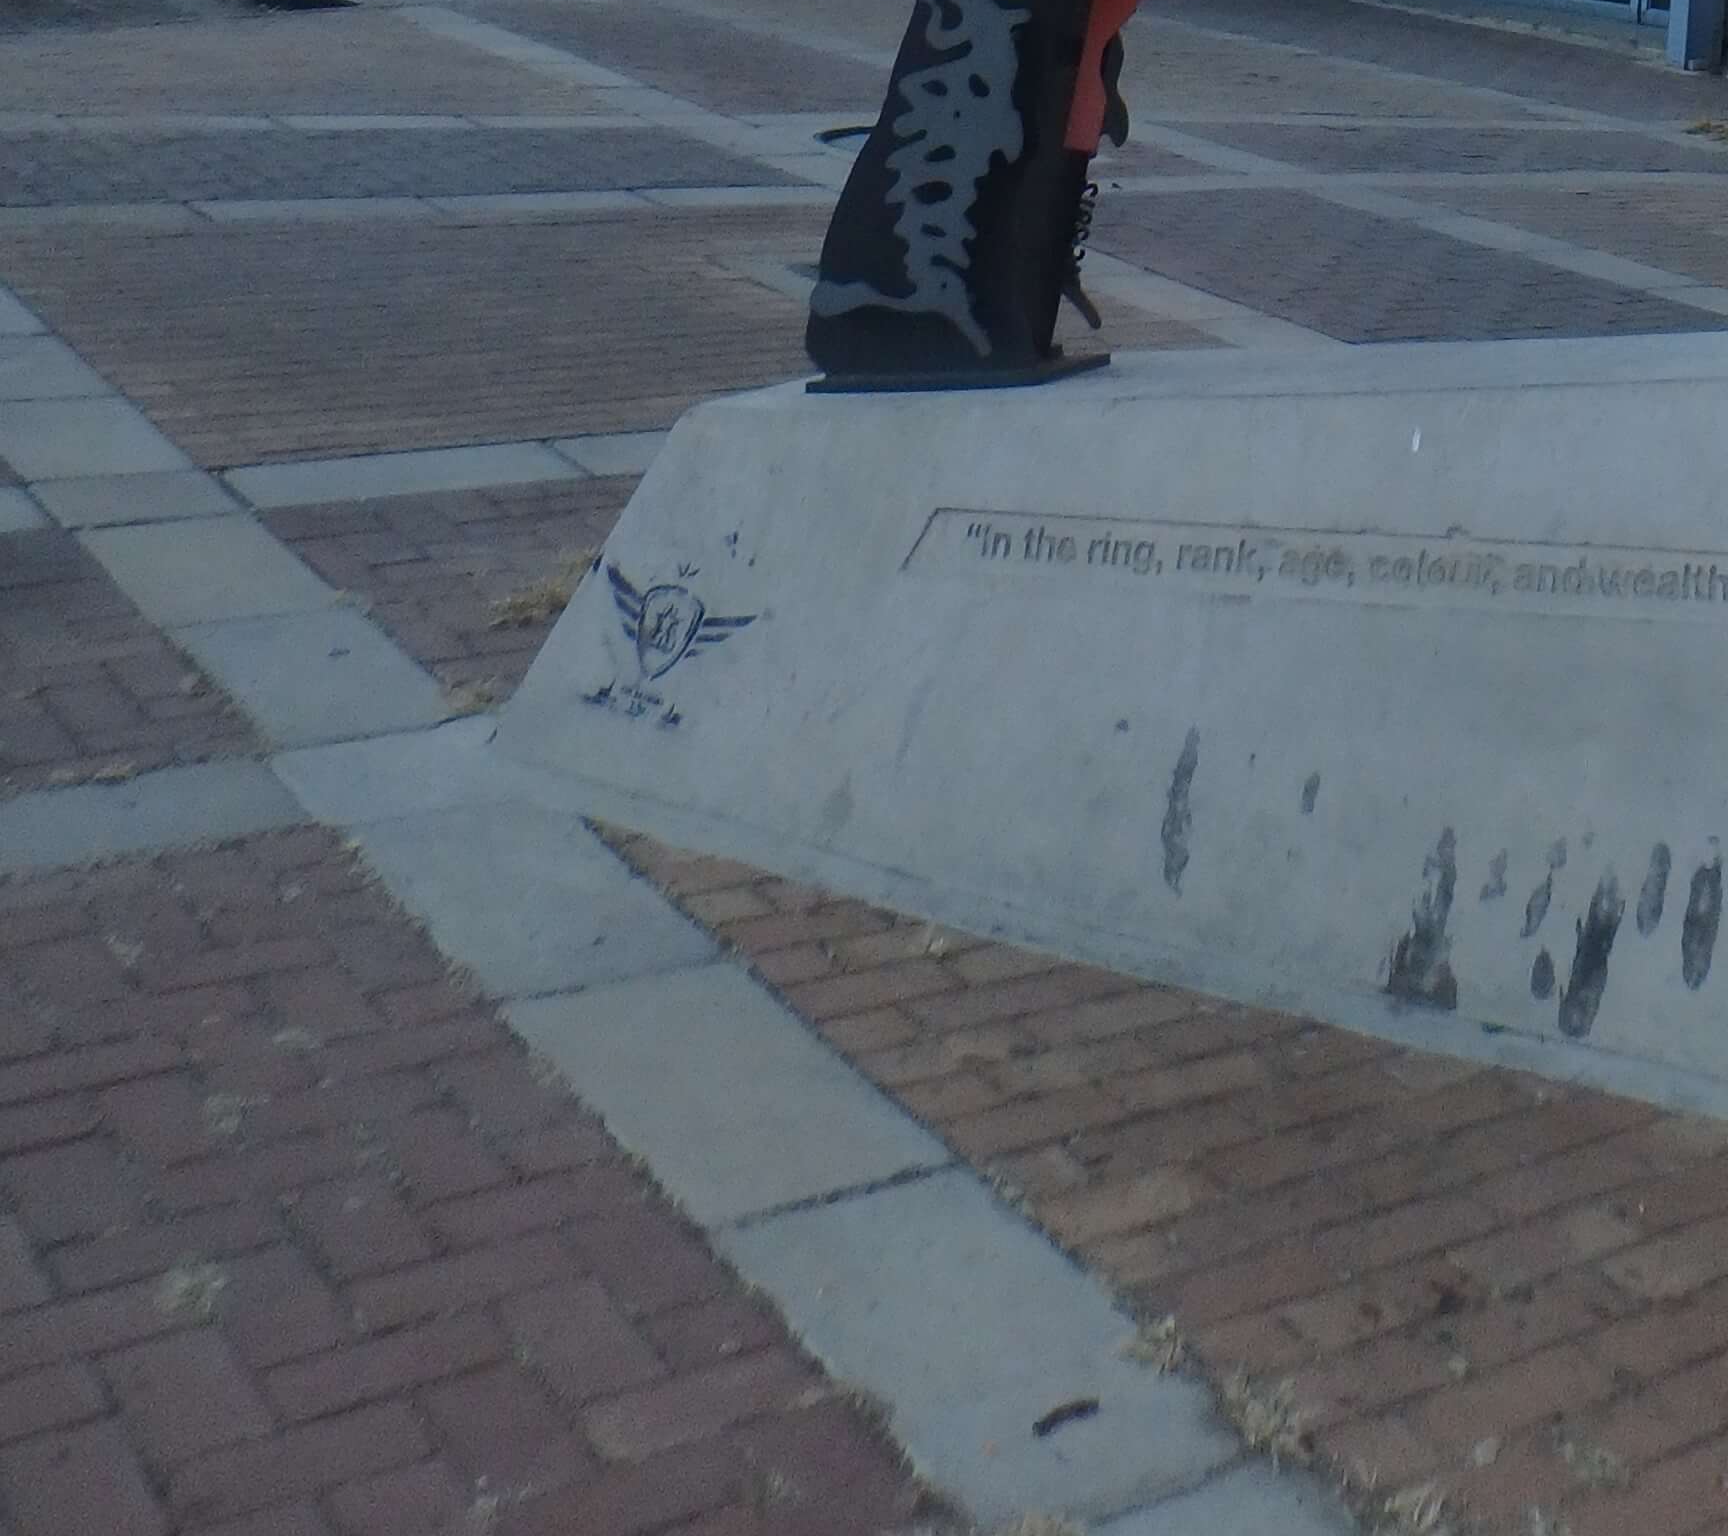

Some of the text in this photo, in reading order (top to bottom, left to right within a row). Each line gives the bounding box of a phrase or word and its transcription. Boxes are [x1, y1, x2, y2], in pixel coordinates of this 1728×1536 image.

[1023, 525, 1077, 564] the
[1087, 530, 1163, 576] ring,
[1176, 538, 1265, 583] rank,
[1279, 548, 1355, 589] age,
[1513, 555, 1588, 595] and
